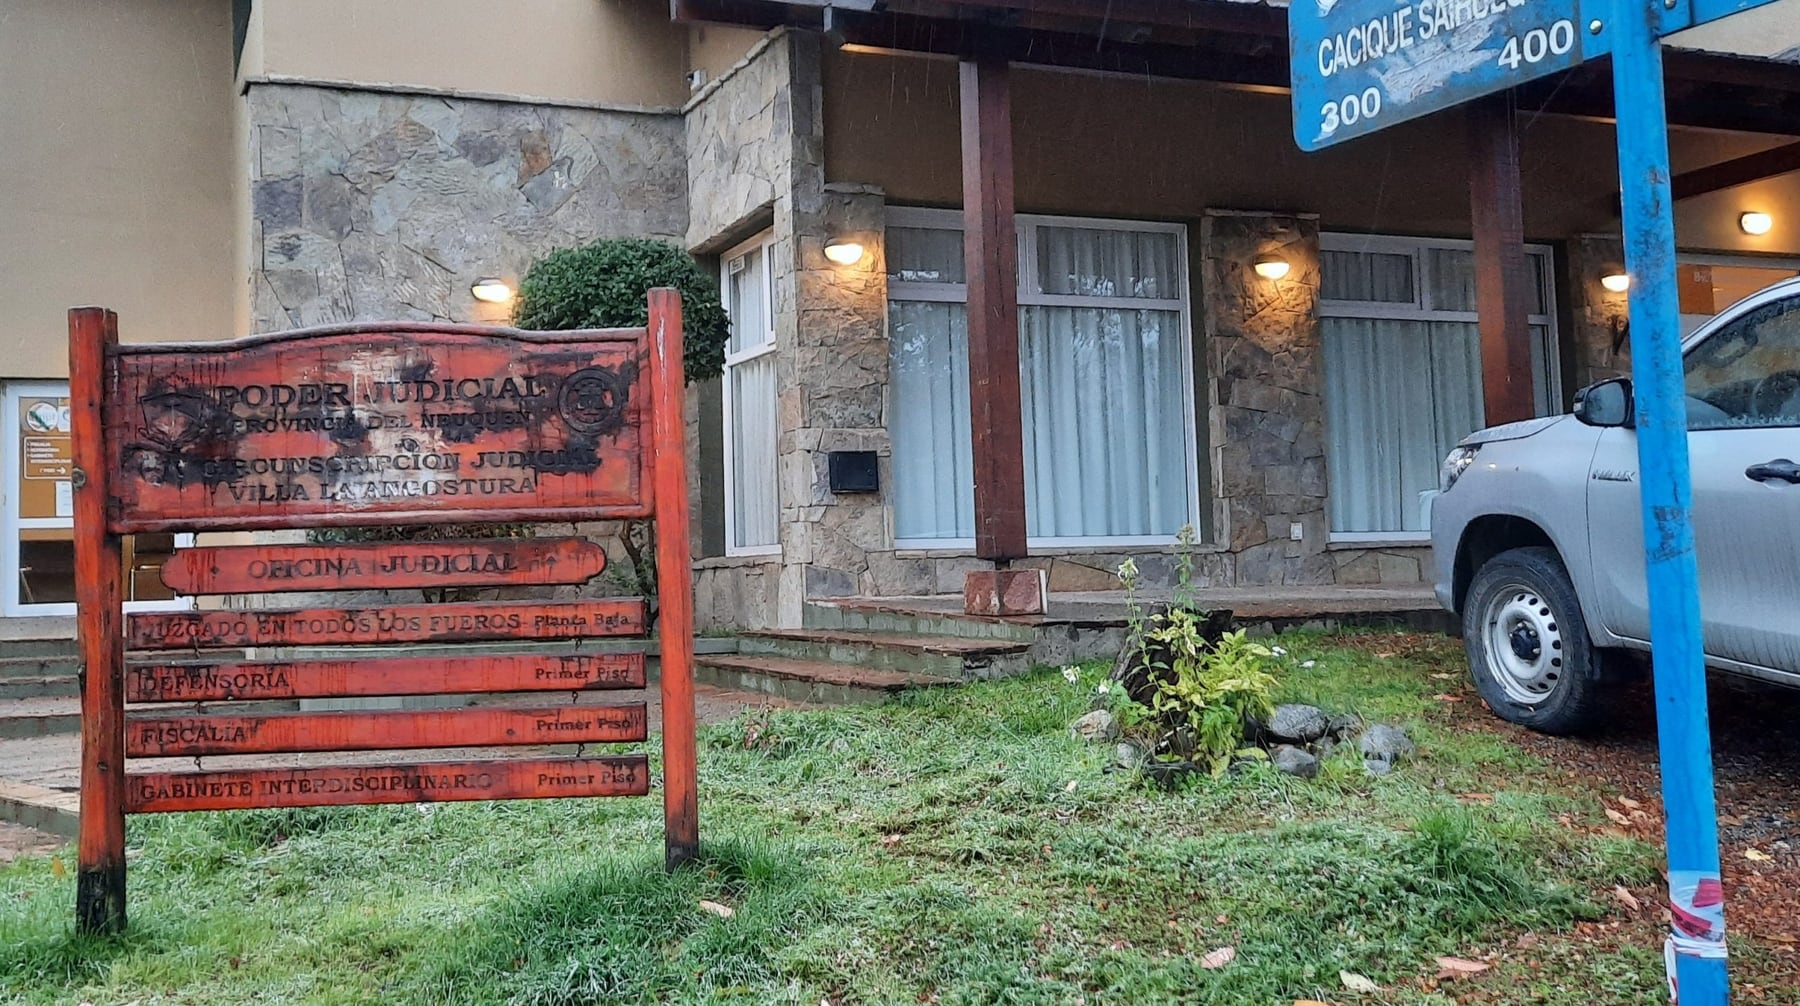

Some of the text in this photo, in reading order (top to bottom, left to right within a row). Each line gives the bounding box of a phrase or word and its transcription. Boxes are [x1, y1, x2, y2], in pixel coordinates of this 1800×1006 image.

[1318, 6, 1414, 77] CACIQUE
[1498, 19, 1574, 69] 400
[1321, 86, 1381, 133] 300
[216, 375, 546, 407] PODER JUDICIAL
[366, 415, 412, 430] DEL
[229, 477, 536, 502] VILLA LA ANGOSTURA
[248, 553, 517, 579] OFICINA JUDICIAL
[258, 620, 285, 635] EN
[294, 618, 371, 634] TODOS
[379, 615, 421, 632] LOS
[430, 614, 520, 631] FUEROS
[534, 614, 587, 626] Planta
[594, 612, 629, 629] Baja
[535, 666, 590, 679] Primer
[597, 666, 629, 680] Piso
[536, 719, 592, 731] Primer
[141, 770, 636, 800] GABINETE INTERDISCIPLINARIO Primer Piso
